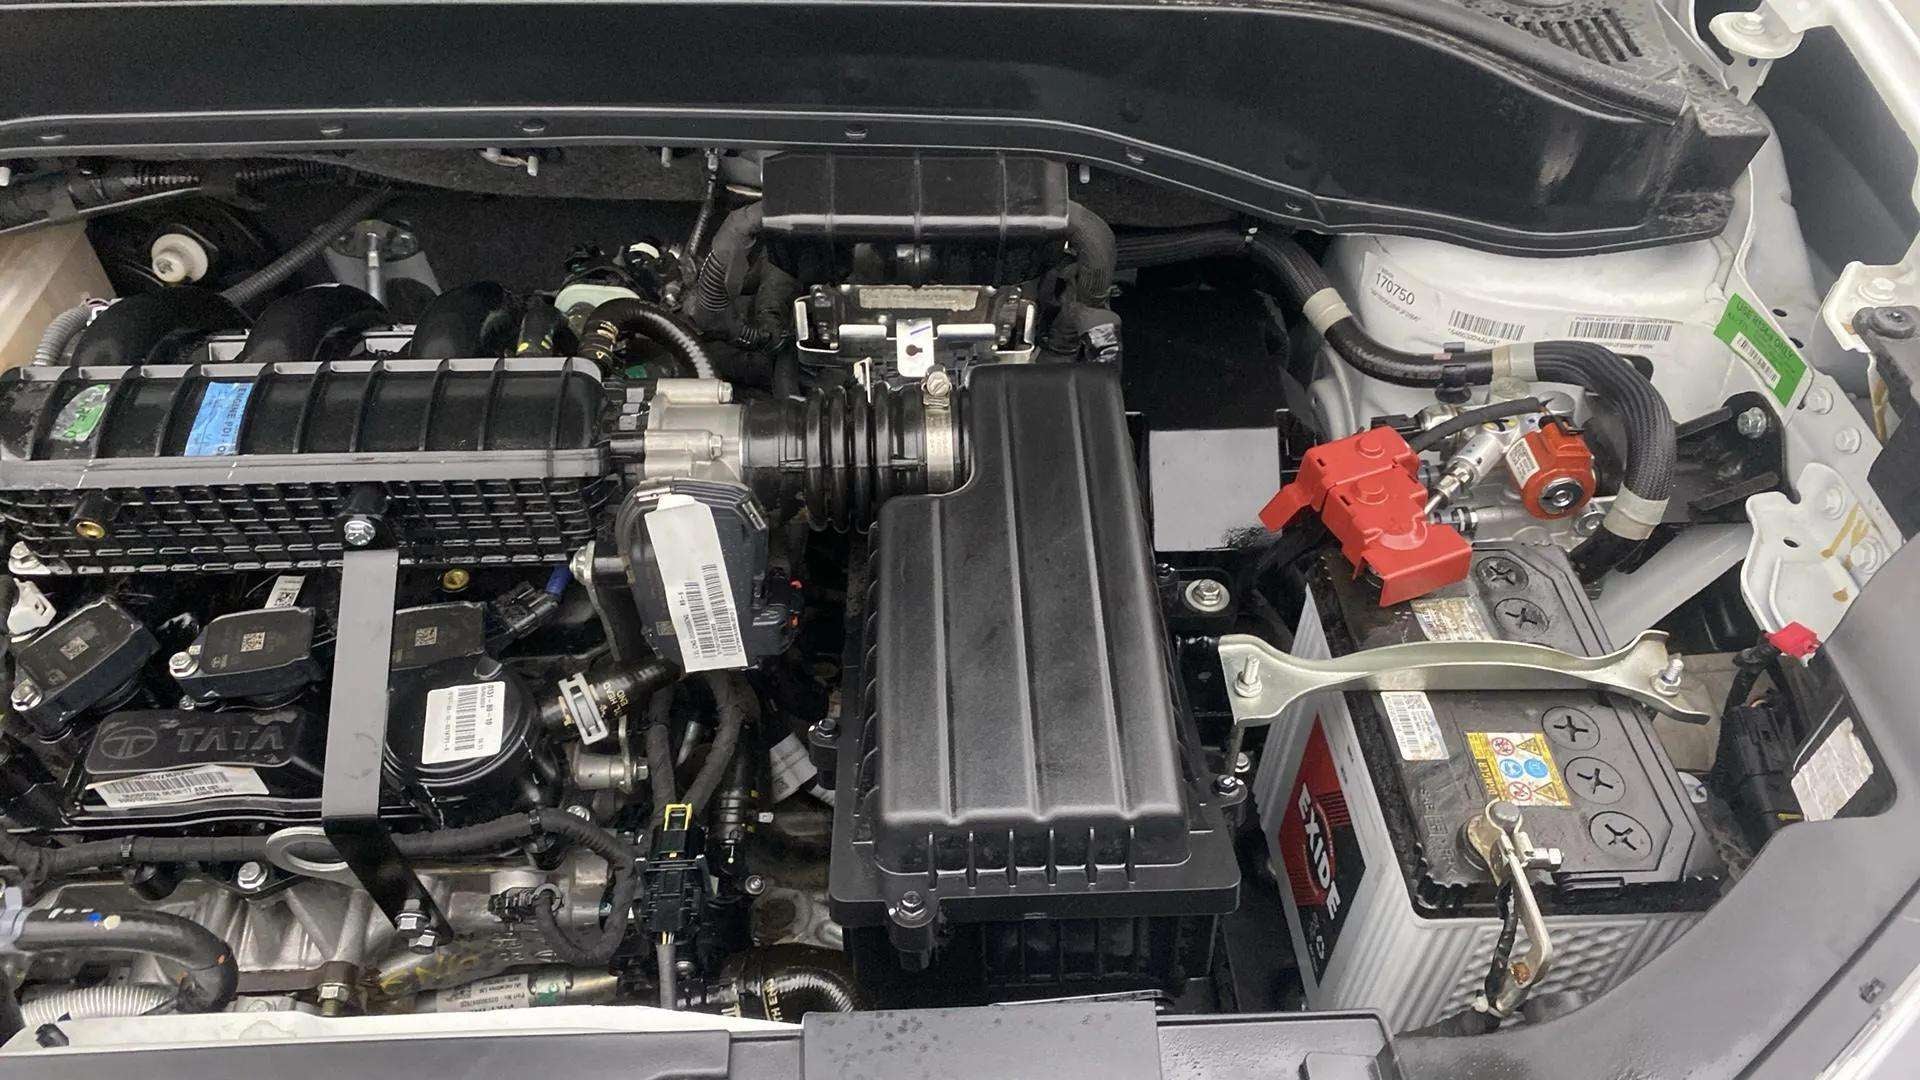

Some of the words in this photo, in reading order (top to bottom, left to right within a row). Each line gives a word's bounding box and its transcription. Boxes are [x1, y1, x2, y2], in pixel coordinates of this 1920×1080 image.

[1376, 272, 1416, 306] 170750
[227, 388, 247, 418] ENGINE
[603, 681, 617, 704] HEAD
[617, 690, 628, 706] END
[177, 725, 284, 752] TATA
[1298, 783, 1343, 920] EXIDE
